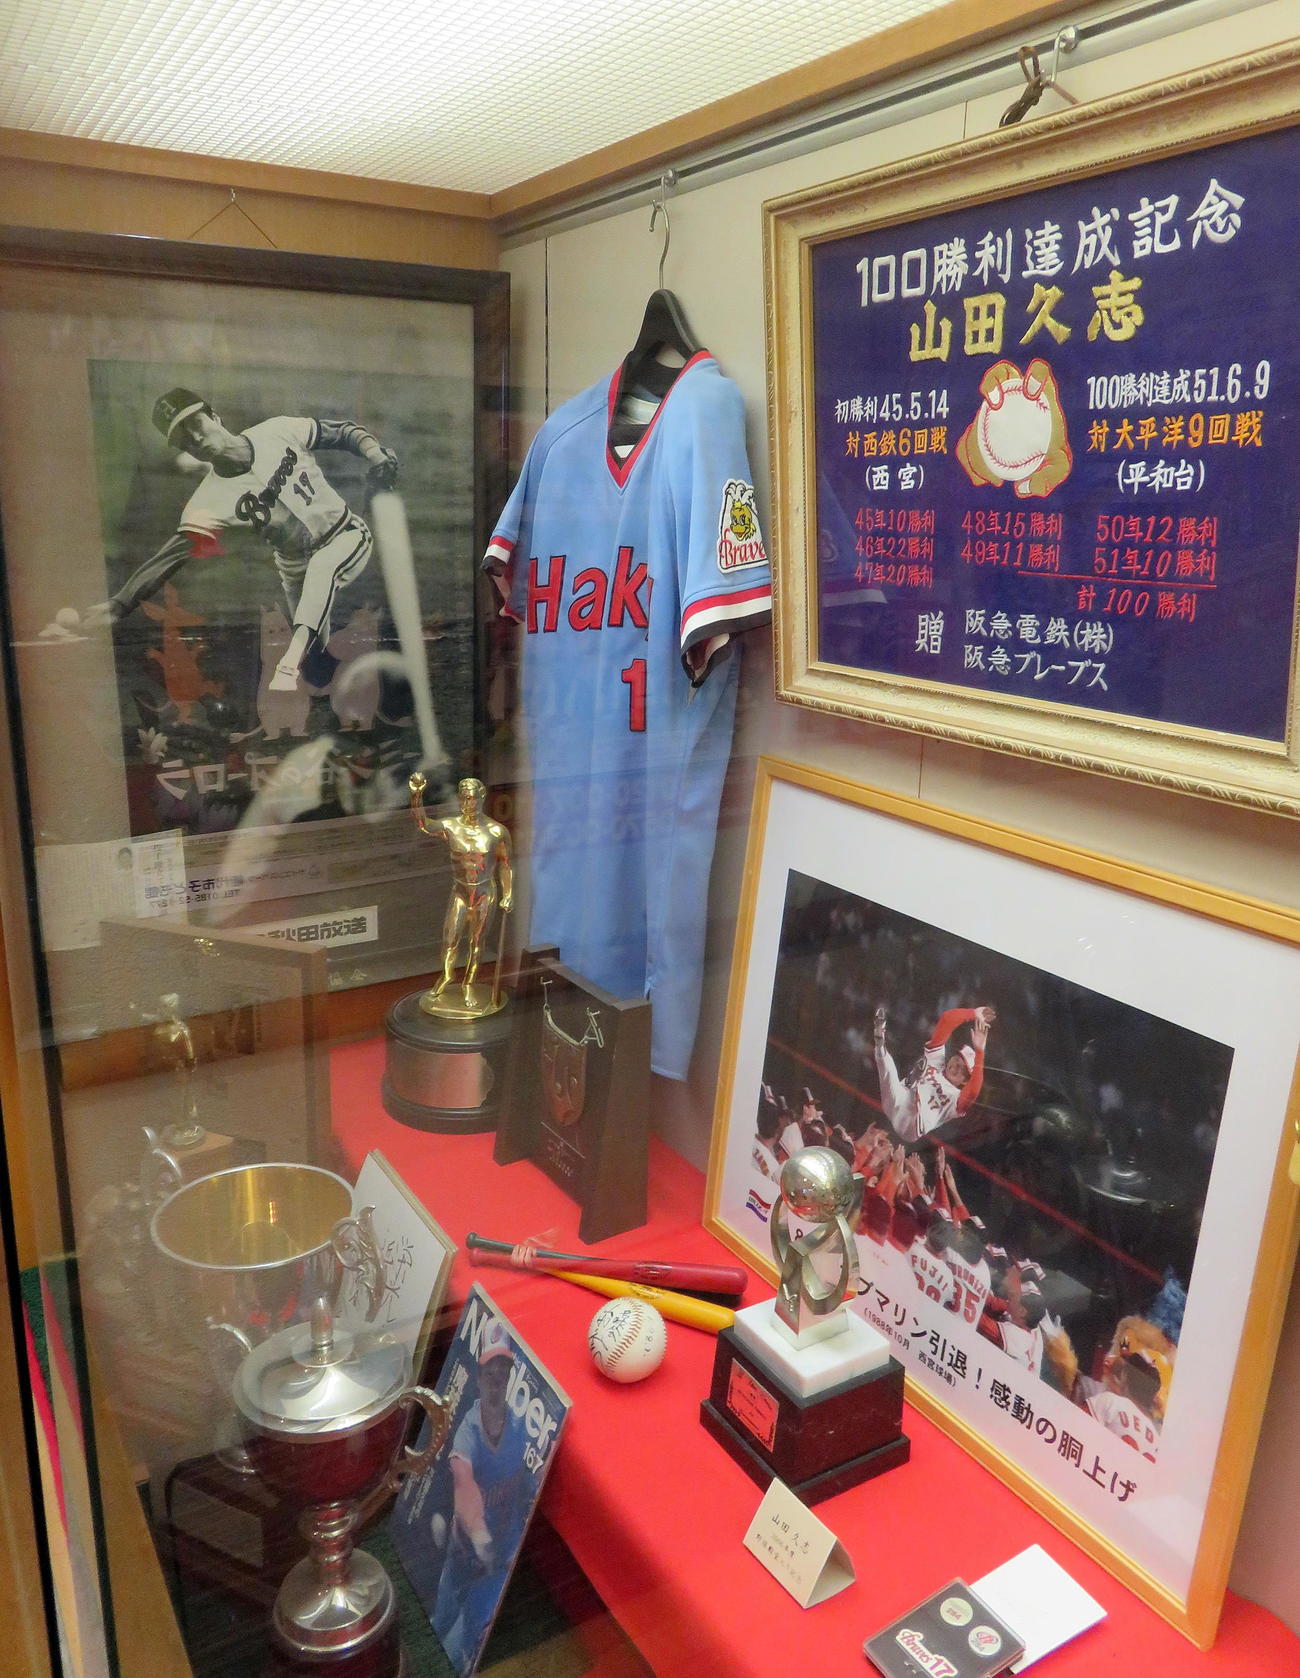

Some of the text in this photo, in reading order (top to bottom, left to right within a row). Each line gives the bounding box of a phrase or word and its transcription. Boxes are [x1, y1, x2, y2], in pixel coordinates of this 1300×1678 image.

[856, 177, 1246, 307] 100勝利達成記念
[908, 269, 1145, 363] 山田久志
[845, 424, 948, 458] 対西鉄6回戦
[526, 545, 655, 642] Hak
[1118, 1411, 1157, 1450] UED
